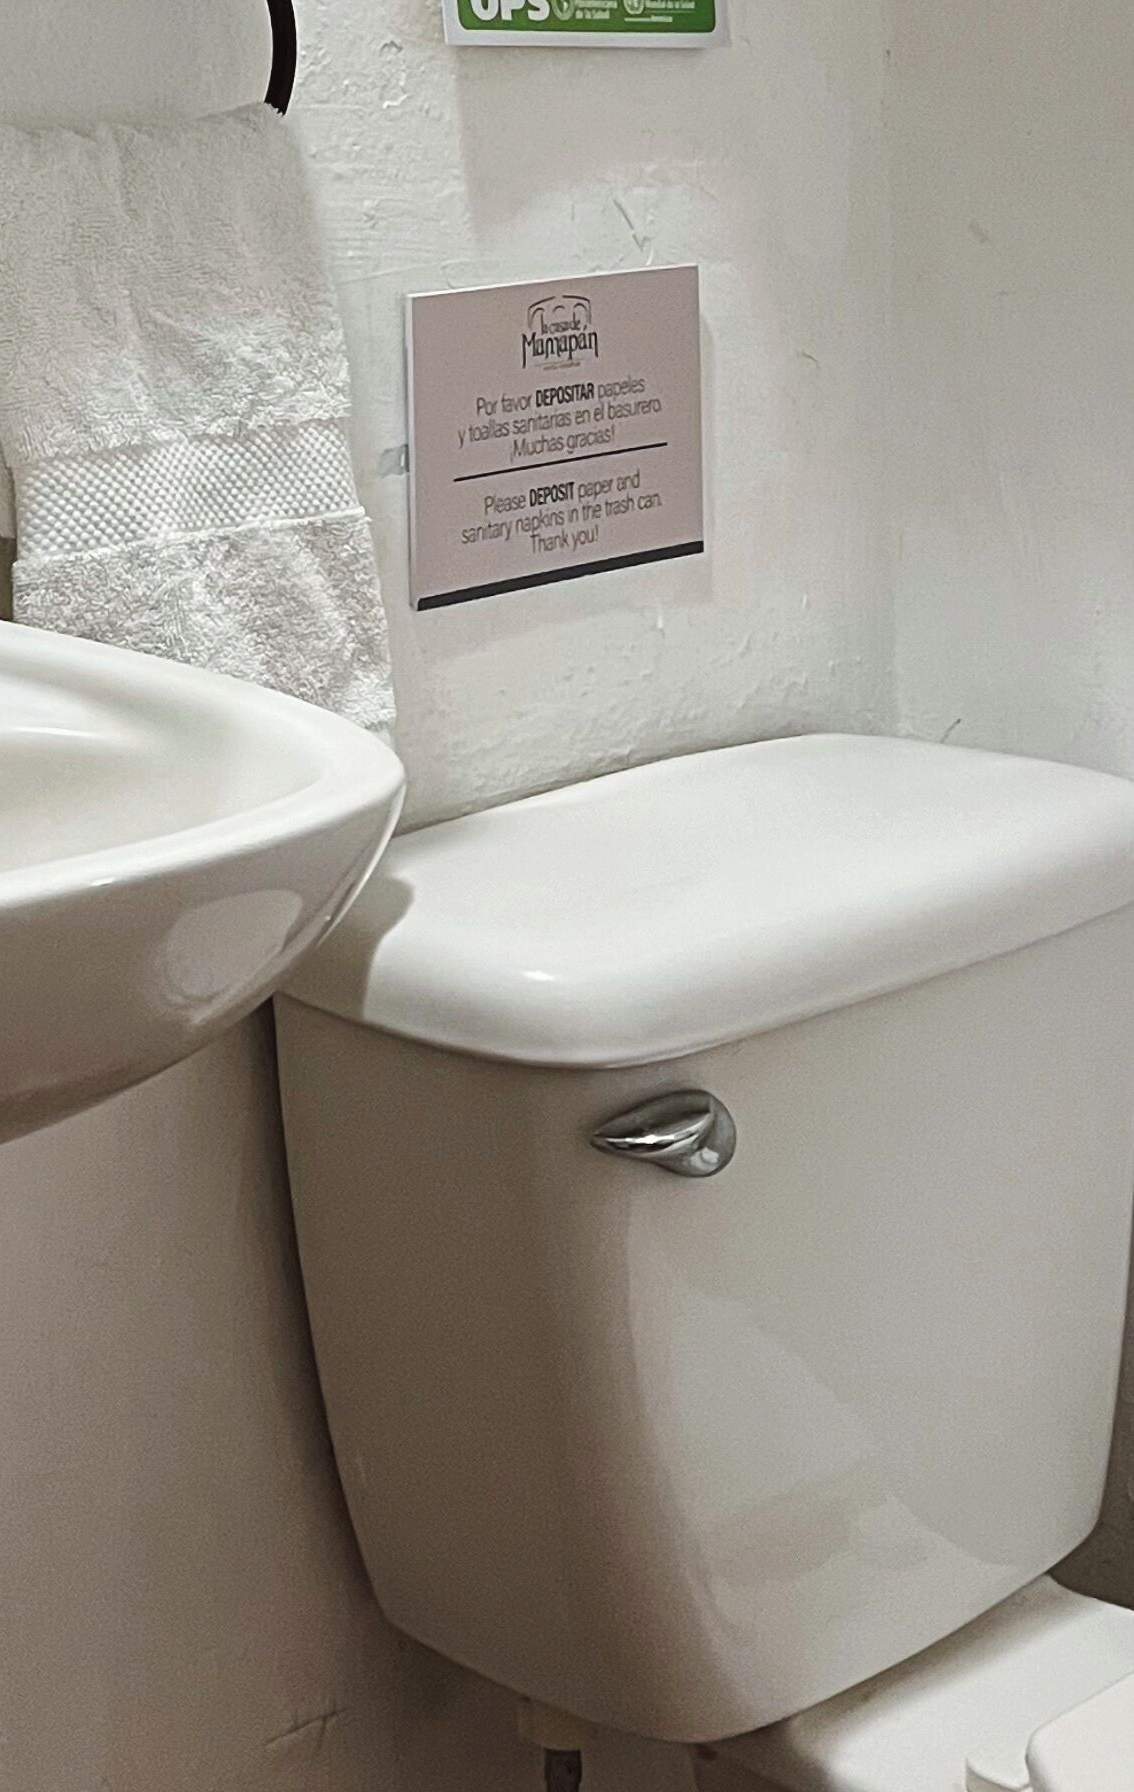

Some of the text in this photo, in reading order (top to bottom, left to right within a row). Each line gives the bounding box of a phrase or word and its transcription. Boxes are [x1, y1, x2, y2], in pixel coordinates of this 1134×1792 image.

[476, 375, 645, 416] Por favor DEPOSITAR papeles
[458, 429, 466, 449] y
[468, 419, 510, 443] toallas
[512, 411, 572, 435] sanitarias
[575, 409, 591, 425] en
[594, 400, 604, 422] el
[566, 424, 615, 455] gracias!
[484, 468, 640, 516] Please DEPOSIT paper and
[462, 521, 512, 545] sanitary
[515, 509, 565, 537] napkins
[568, 506, 579, 523] in
[582, 502, 602, 521] the
[605, 492, 635, 517] trash
[530, 524, 599, 554] Thank you!
